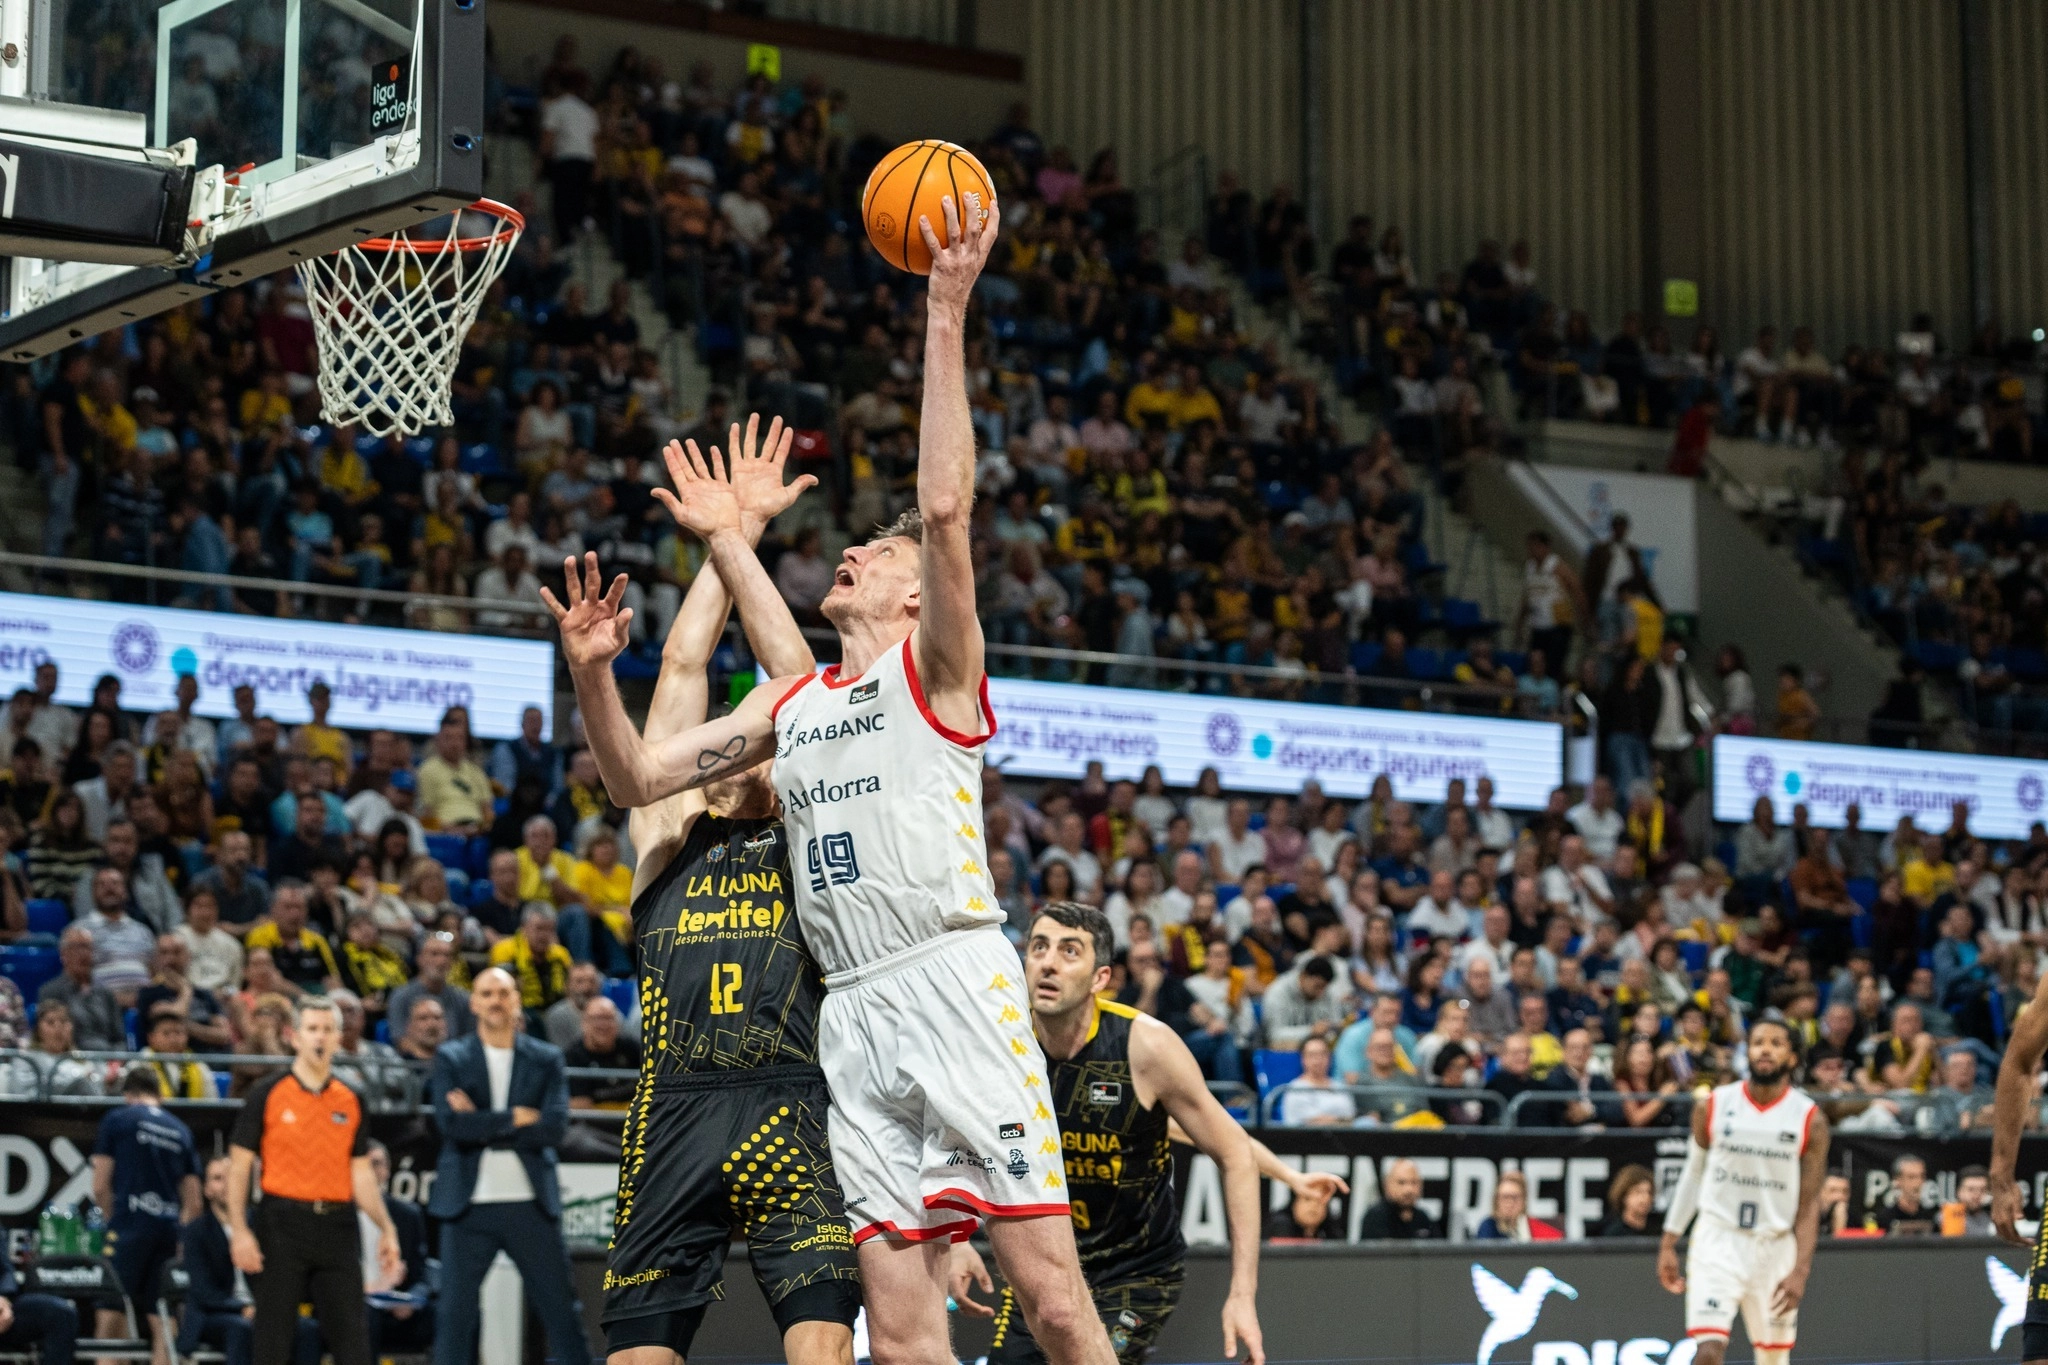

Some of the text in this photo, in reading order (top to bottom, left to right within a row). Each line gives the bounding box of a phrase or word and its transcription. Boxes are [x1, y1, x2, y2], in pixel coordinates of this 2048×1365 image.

[373, 83, 395, 107] liga
[333, 661, 474, 712] lagunero
[1278, 740, 1374, 776] deporte
[686, 875, 713, 898] LA
[710, 963, 744, 1015] 12
[1001, 1129, 1020, 1138] acb
[1062, 1131, 1121, 1153] GUNA
[1738, 1201, 1757, 1229] 0
[816, 1223, 848, 1235] Islas
[611, 1269, 670, 1289] Hospiten
